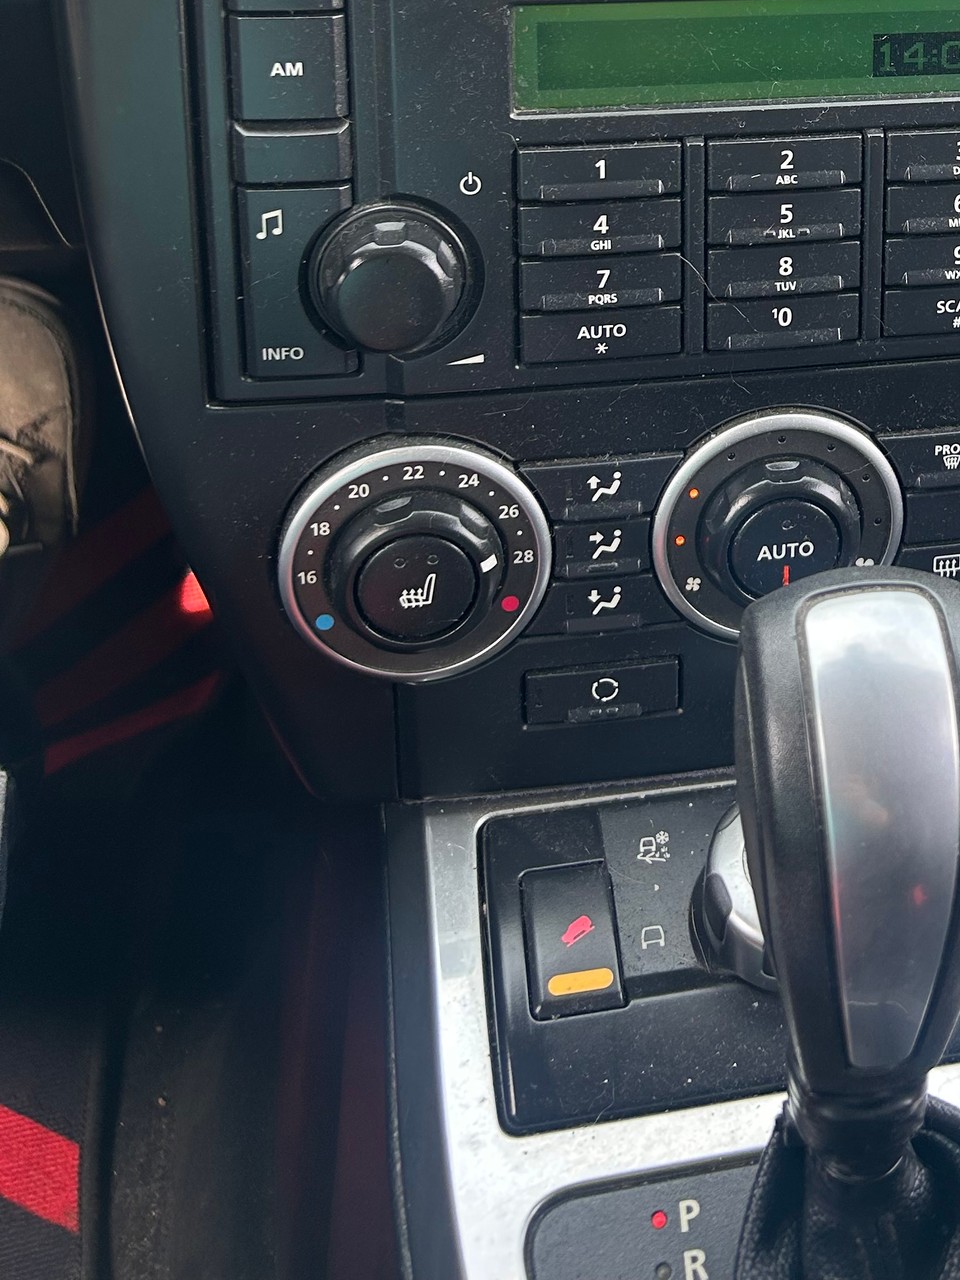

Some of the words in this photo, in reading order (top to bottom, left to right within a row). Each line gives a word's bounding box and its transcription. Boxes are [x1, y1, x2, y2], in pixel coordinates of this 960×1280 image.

[269, 61, 304, 77] AM
[780, 149, 794, 170] 2
[594, 159, 606, 179] 1
[775, 174, 799, 185] ABC
[780, 203, 793, 224] 5
[592, 214, 610, 234] 4
[777, 228, 796, 239] JKL
[590, 239, 612, 251] GHI
[778, 256, 793, 276] 8
[596, 269, 611, 289] 7
[774, 280, 797, 292] TUV
[588, 293, 618, 306] PQRS
[576, 323, 627, 340] AUTO
[262, 347, 304, 361] INFO
[402, 464, 425, 481] 22
[458, 473, 480, 489] 24
[348, 483, 370, 499] 20
[498, 504, 520, 519] 26
[310, 521, 331, 537] 18
[513, 549, 534, 564] 28
[756, 541, 814, 562] AUTO
[297, 570, 317, 585] 16
[678, 1199, 701, 1233] P
[683, 1248, 709, 1280] R
